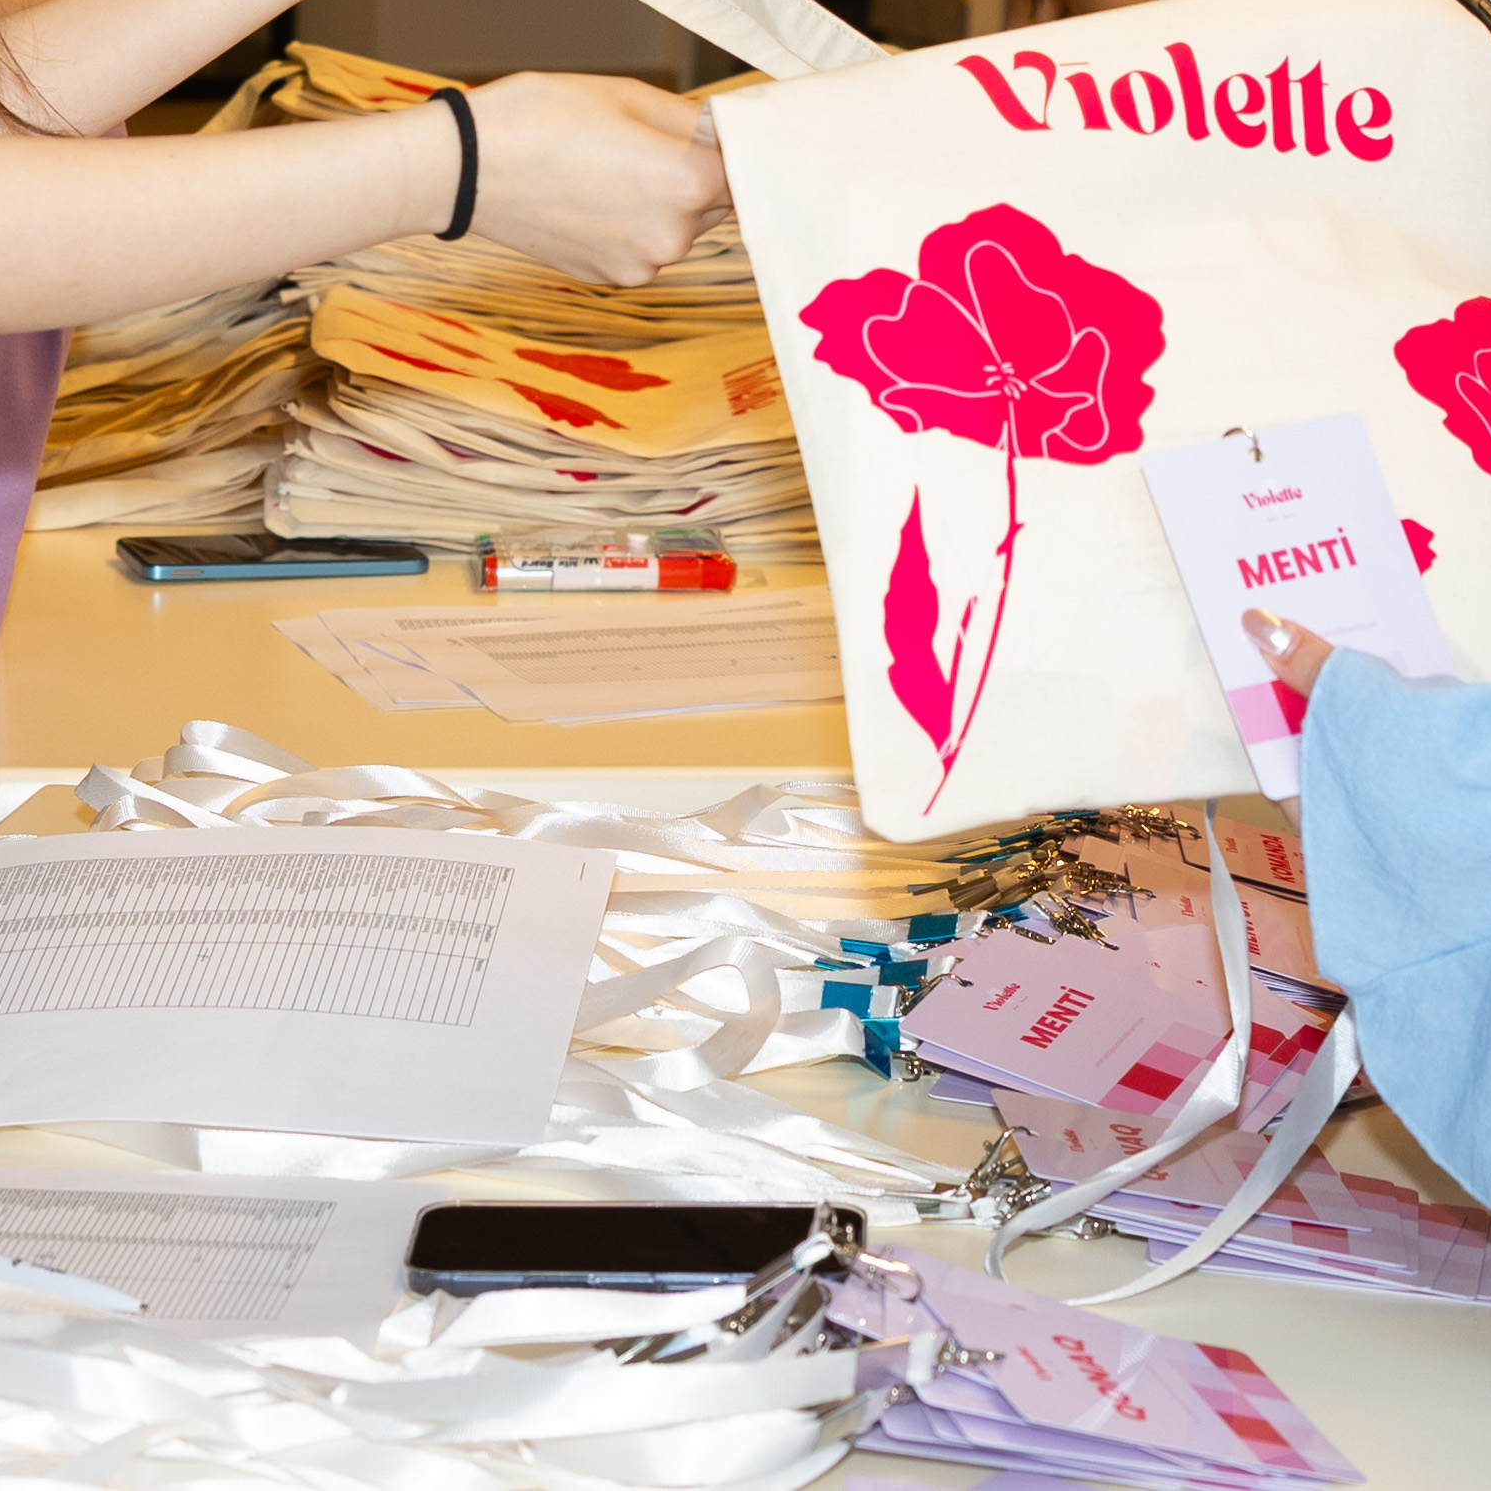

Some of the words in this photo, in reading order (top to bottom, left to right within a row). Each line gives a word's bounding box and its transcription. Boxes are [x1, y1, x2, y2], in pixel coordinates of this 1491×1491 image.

[956, 41, 1395, 163] Violette
[1242, 485, 1304, 510] Violette
[1237, 527, 1357, 589] MENTİ
[1260, 833, 1296, 884] KOMANDA
[982, 982, 1022, 1011] Violette
[1020, 985, 1096, 1050] MENTİ
